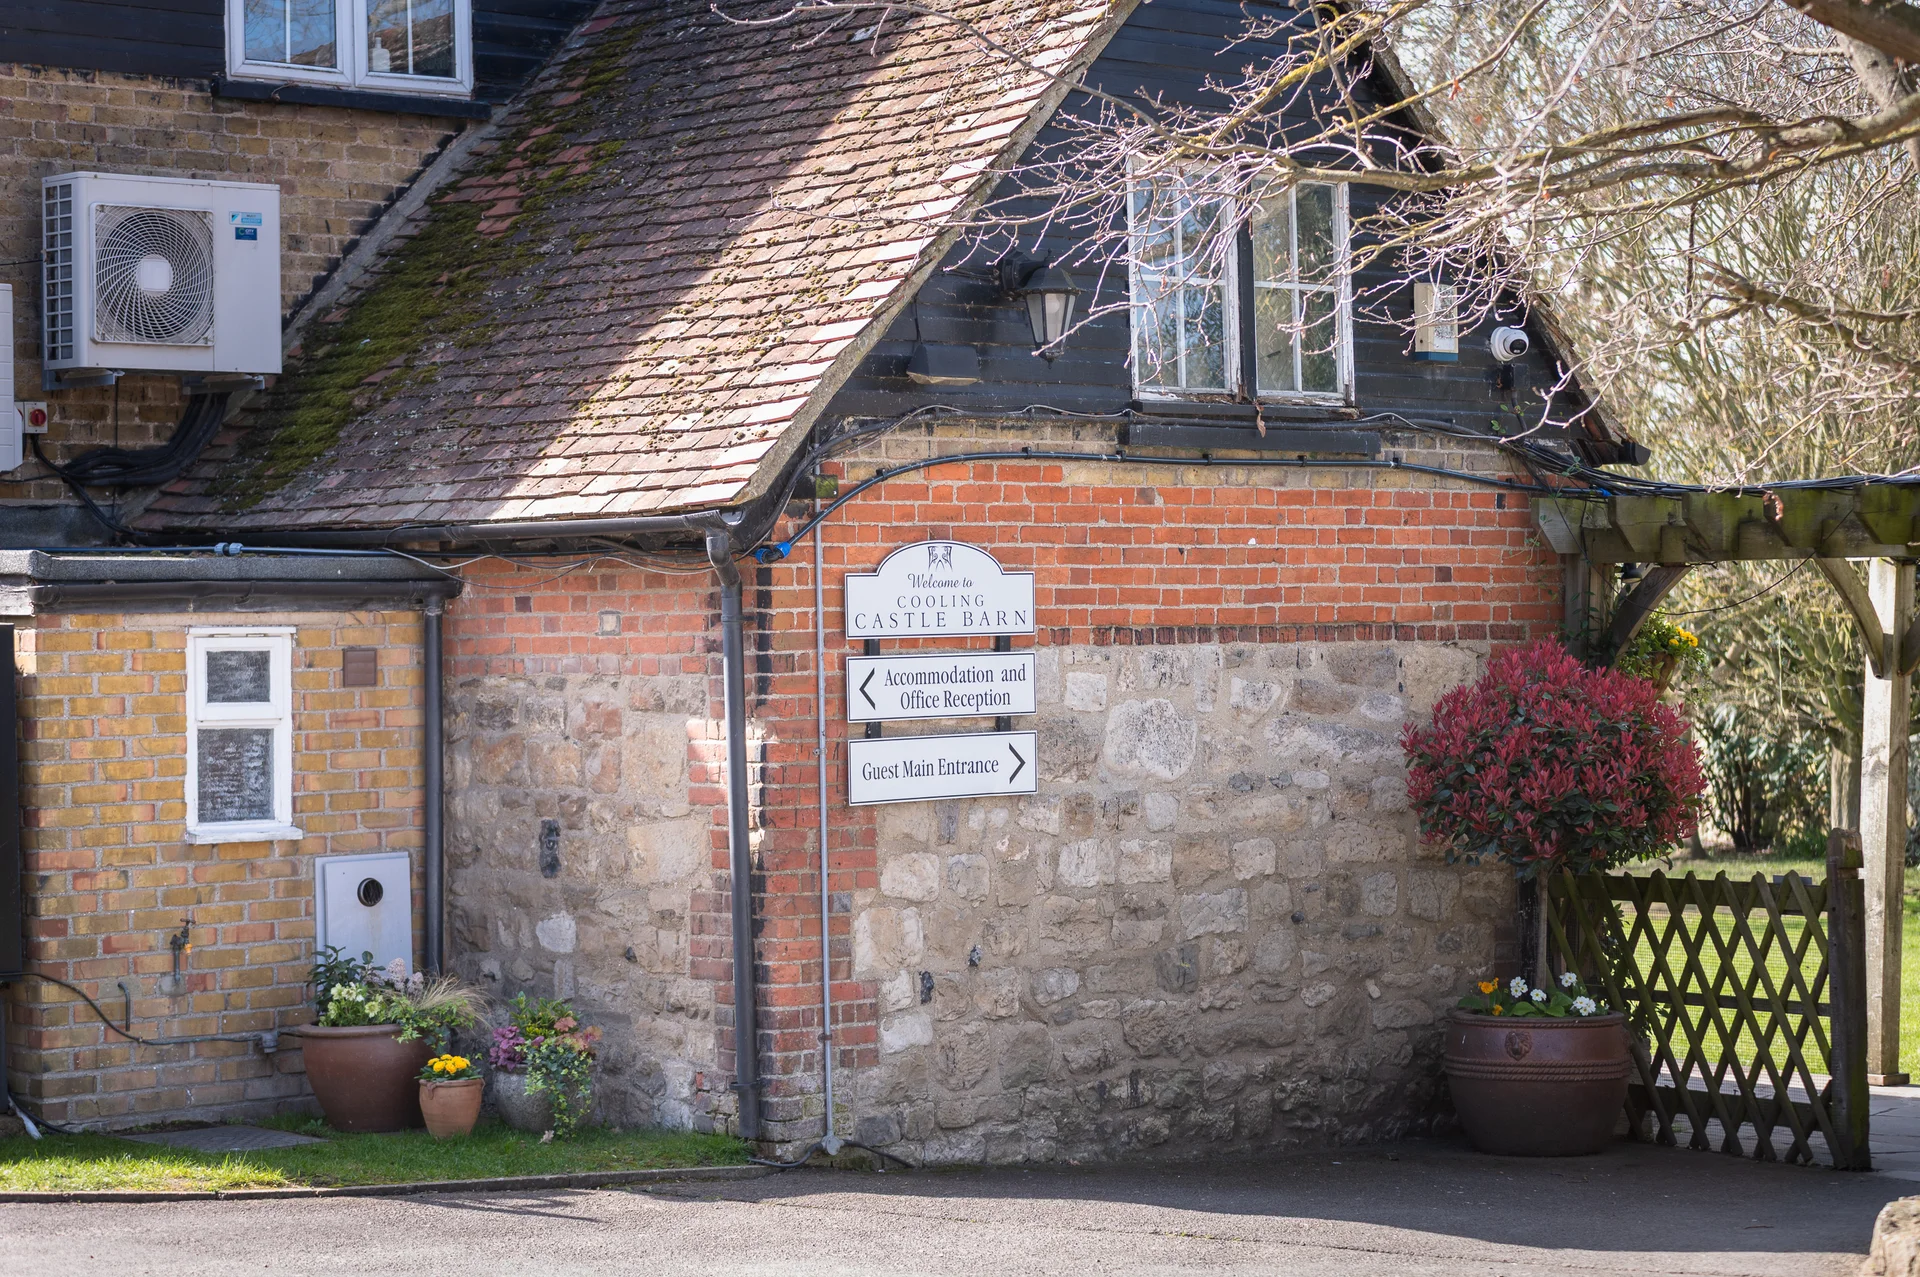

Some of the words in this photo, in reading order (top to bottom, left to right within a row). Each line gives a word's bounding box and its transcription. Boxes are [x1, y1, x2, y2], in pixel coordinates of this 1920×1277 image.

[907, 573, 960, 589] Welcome
[962, 574, 974, 588] to
[897, 594, 984, 608] COOLING
[855, 612, 946, 629] CASTLE
[963, 610, 1027, 627] BARN
[884, 665, 994, 687] Accommodation
[1001, 663, 1026, 683] and
[900, 690, 939, 710] Office
[943, 689, 1011, 712] Reception
[862, 762, 899, 781] Guest
[902, 760, 934, 778] Main
[938, 758, 999, 776] Entrance
